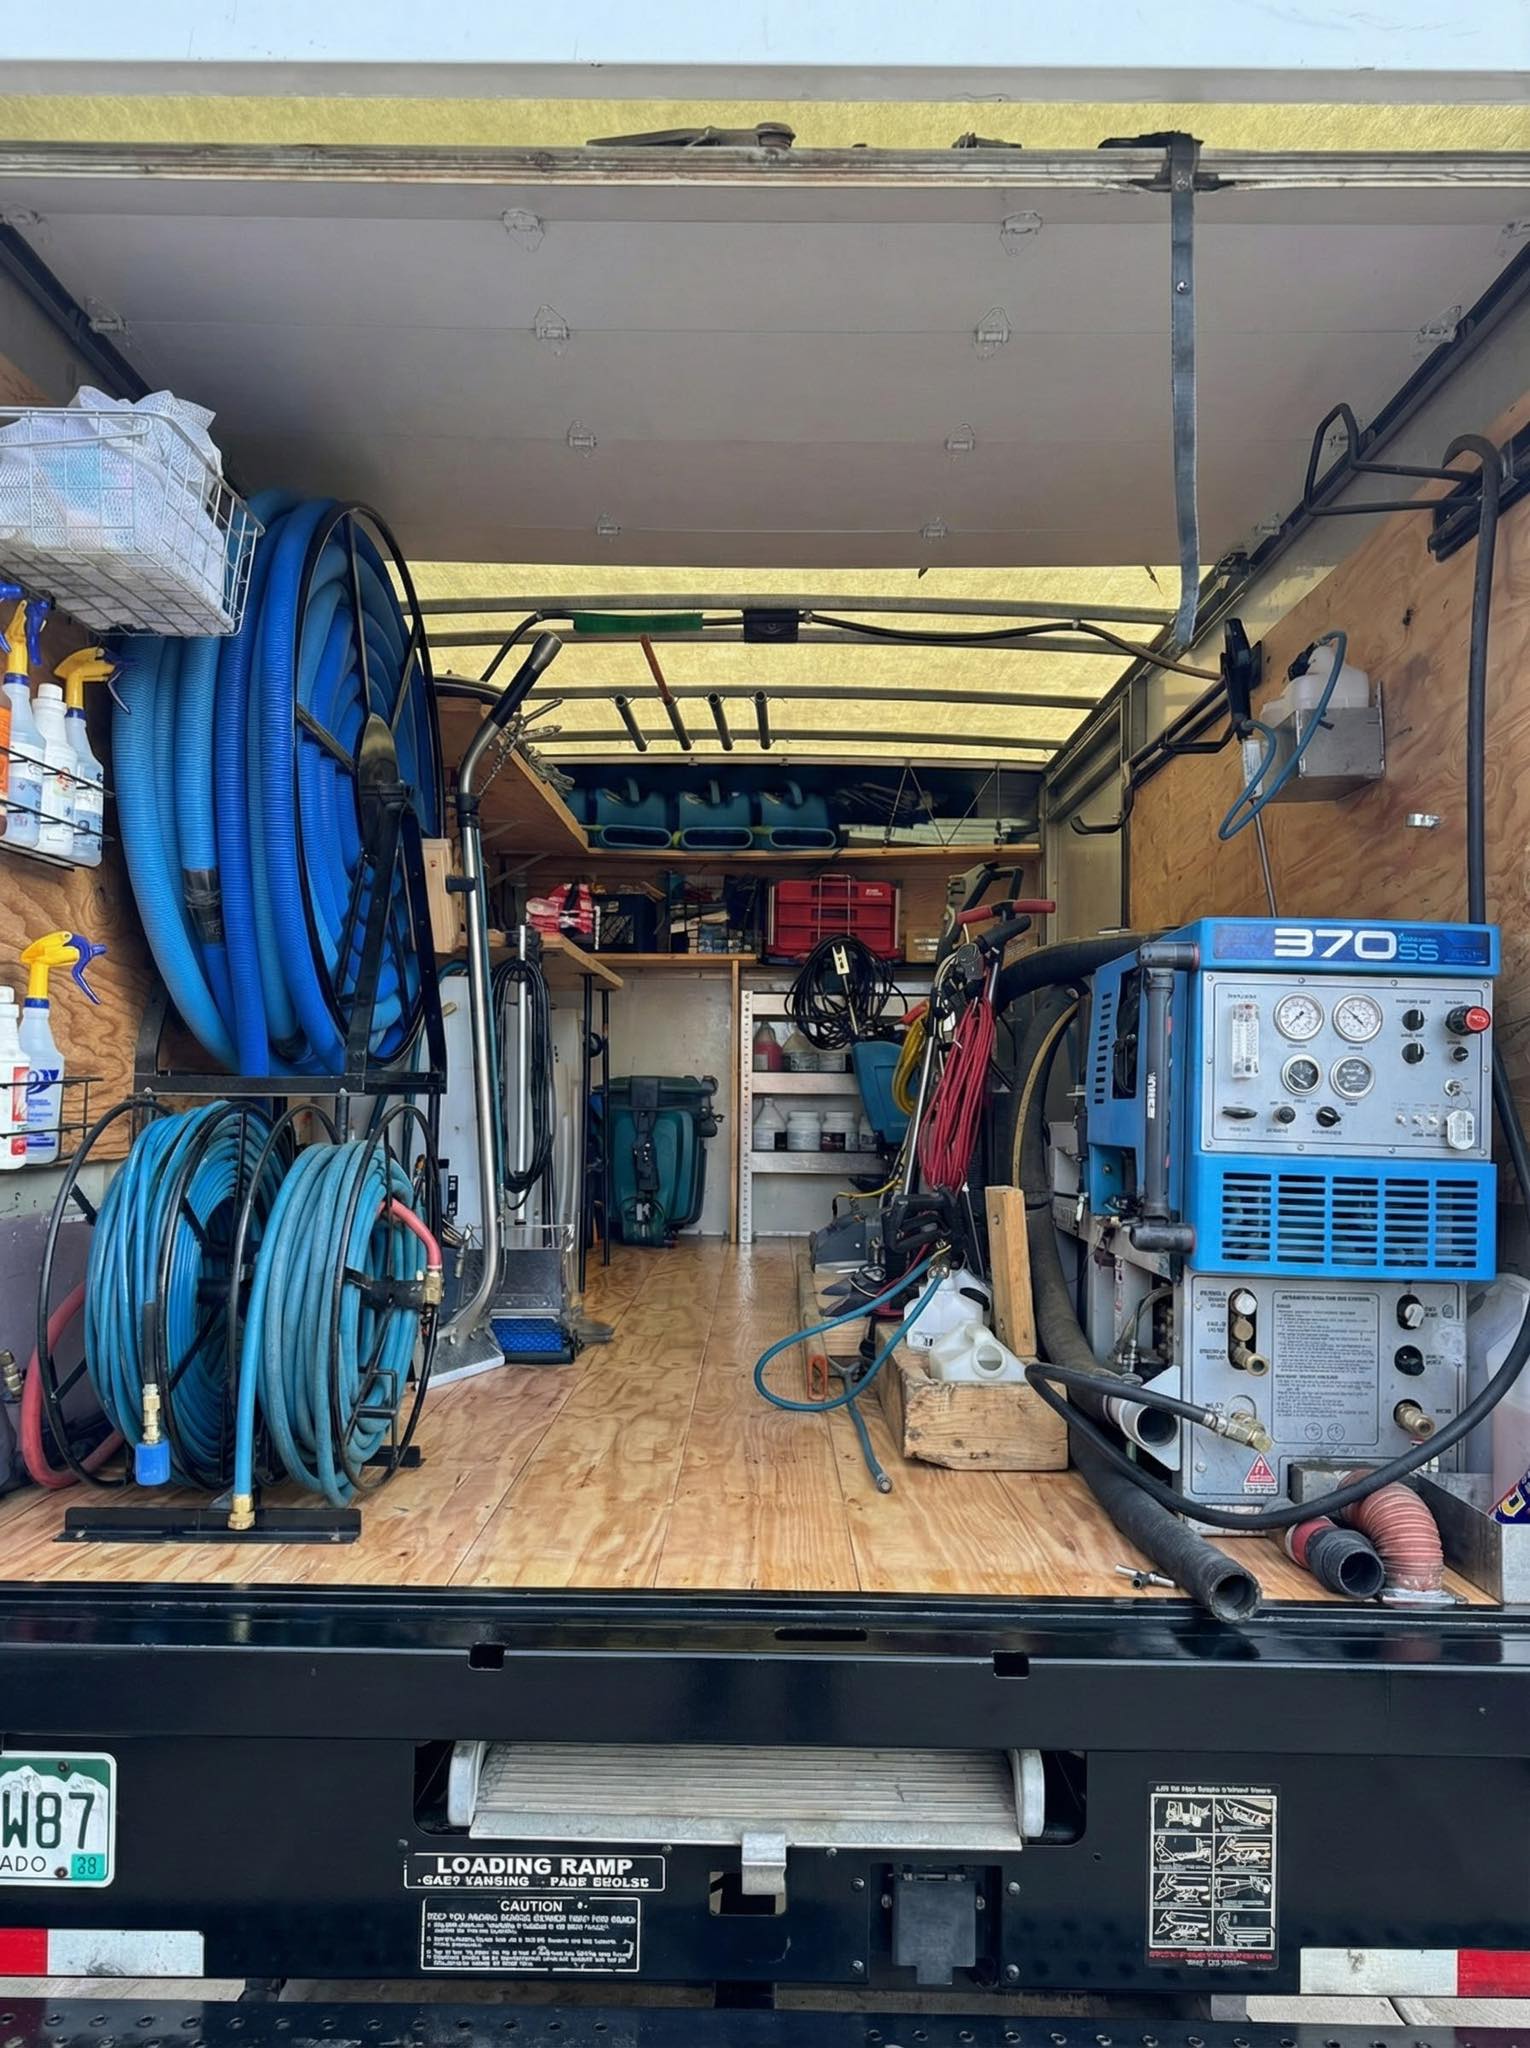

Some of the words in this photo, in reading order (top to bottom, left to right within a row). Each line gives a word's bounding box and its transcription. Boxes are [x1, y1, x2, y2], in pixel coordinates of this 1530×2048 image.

[1274, 928, 1397, 960] 370
[1398, 943, 1439, 961] SS
[2, 1790, 95, 1850] W87
[437, 1856, 552, 1875] LOADING
[561, 1857, 634, 1876] RAMP
[500, 1900, 563, 1912] CAUTION
